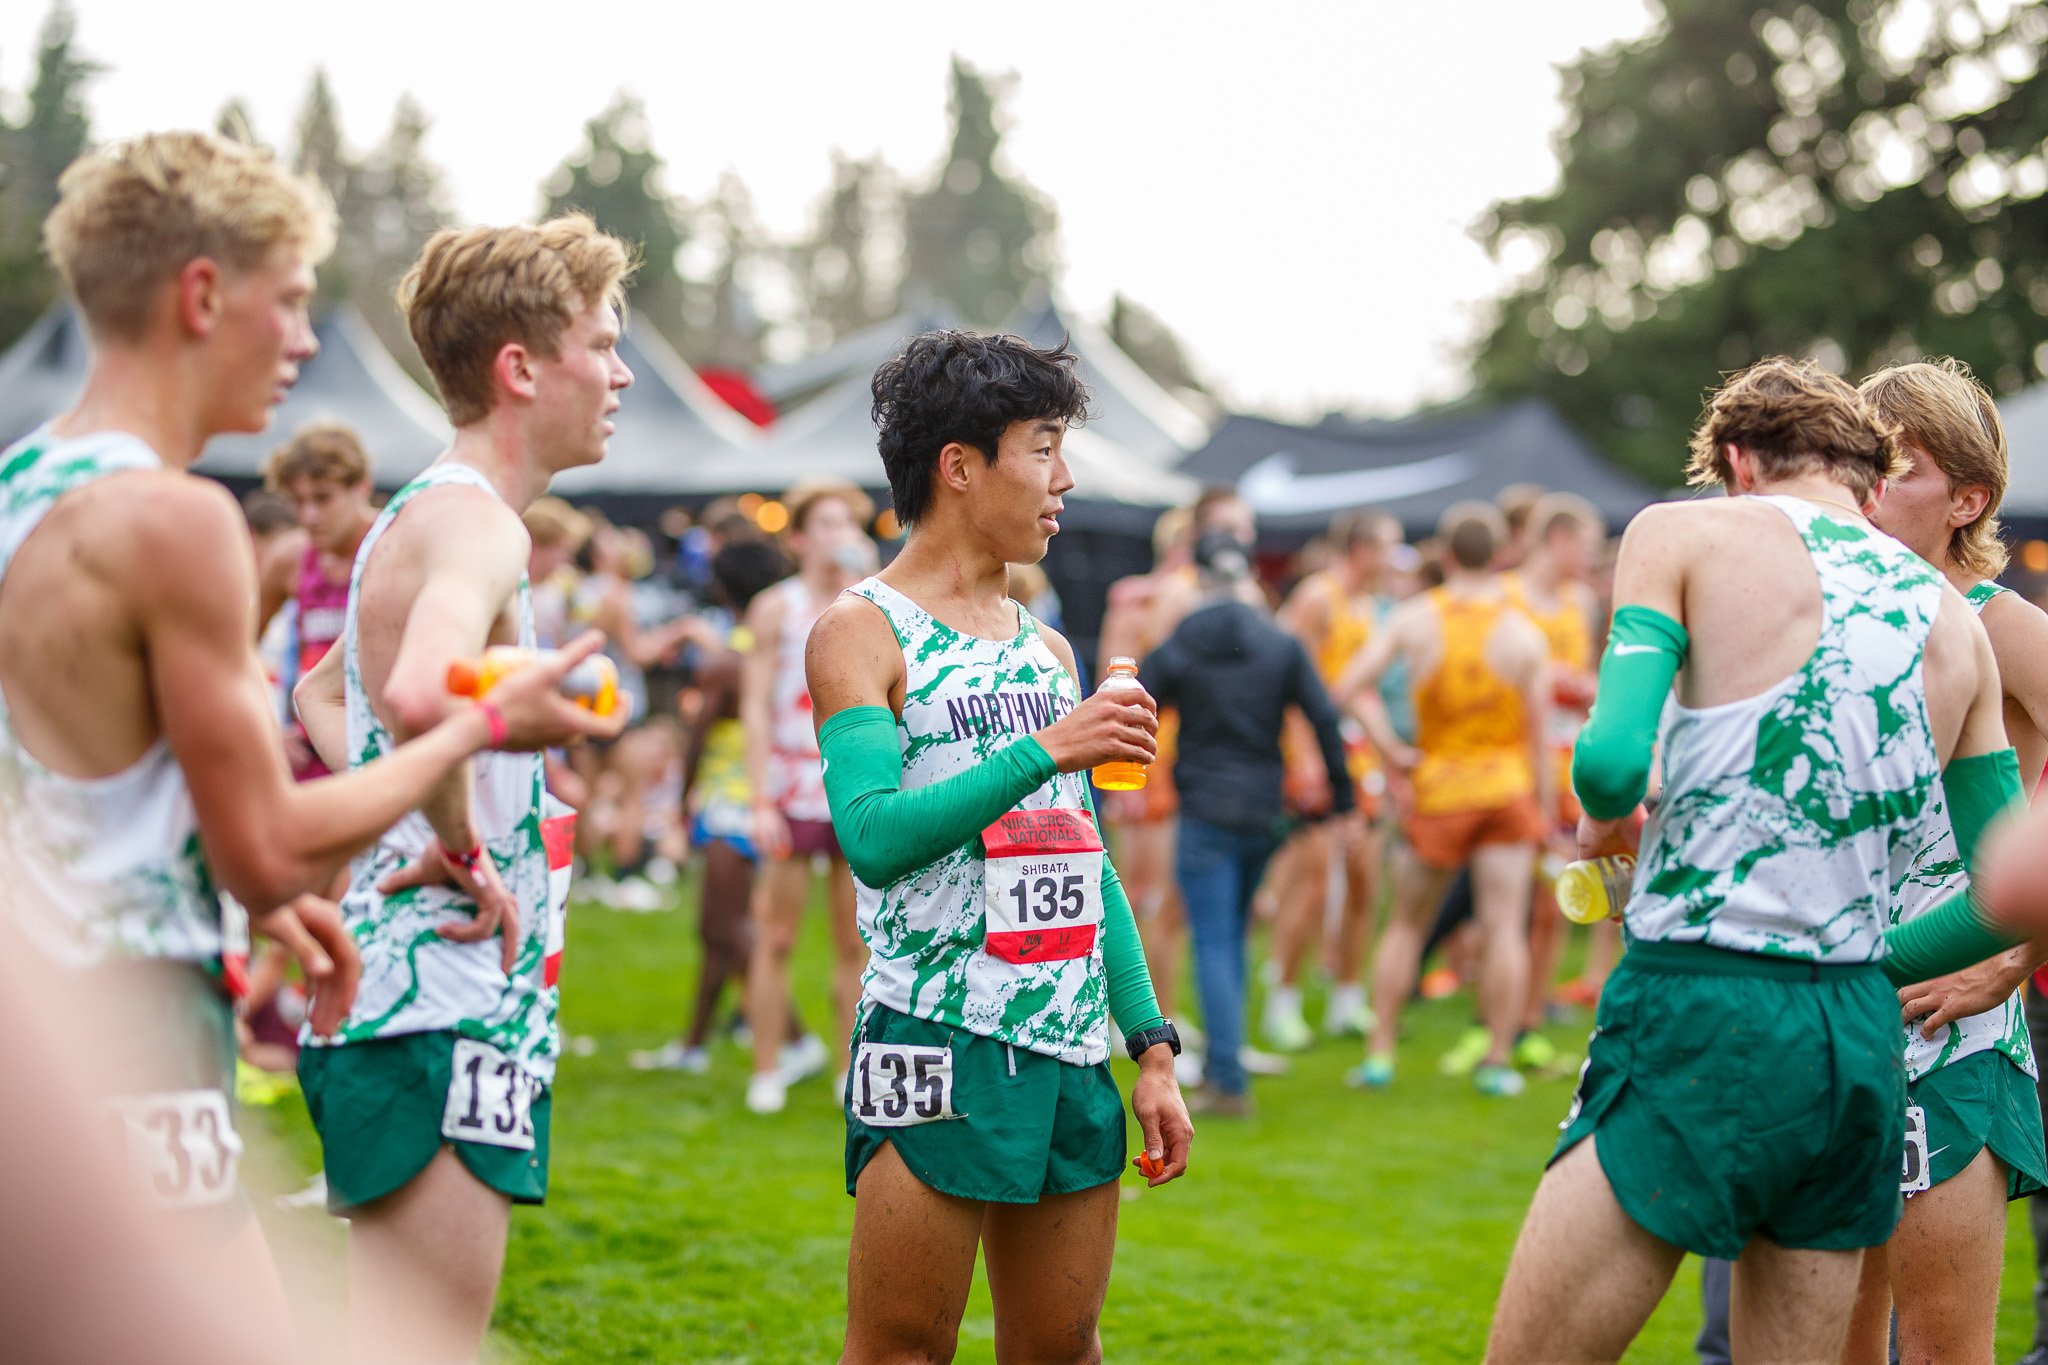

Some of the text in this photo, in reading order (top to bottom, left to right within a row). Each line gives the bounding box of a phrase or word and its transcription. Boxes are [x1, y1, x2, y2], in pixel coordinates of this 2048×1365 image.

[1001, 814, 1082, 831] NIKE CROSS
[1008, 828, 1082, 845] NATIONALS
[1022, 863, 1070, 875] SHIBATA
[1010, 875, 1085, 923] 135
[859, 1052, 944, 1118] 135
